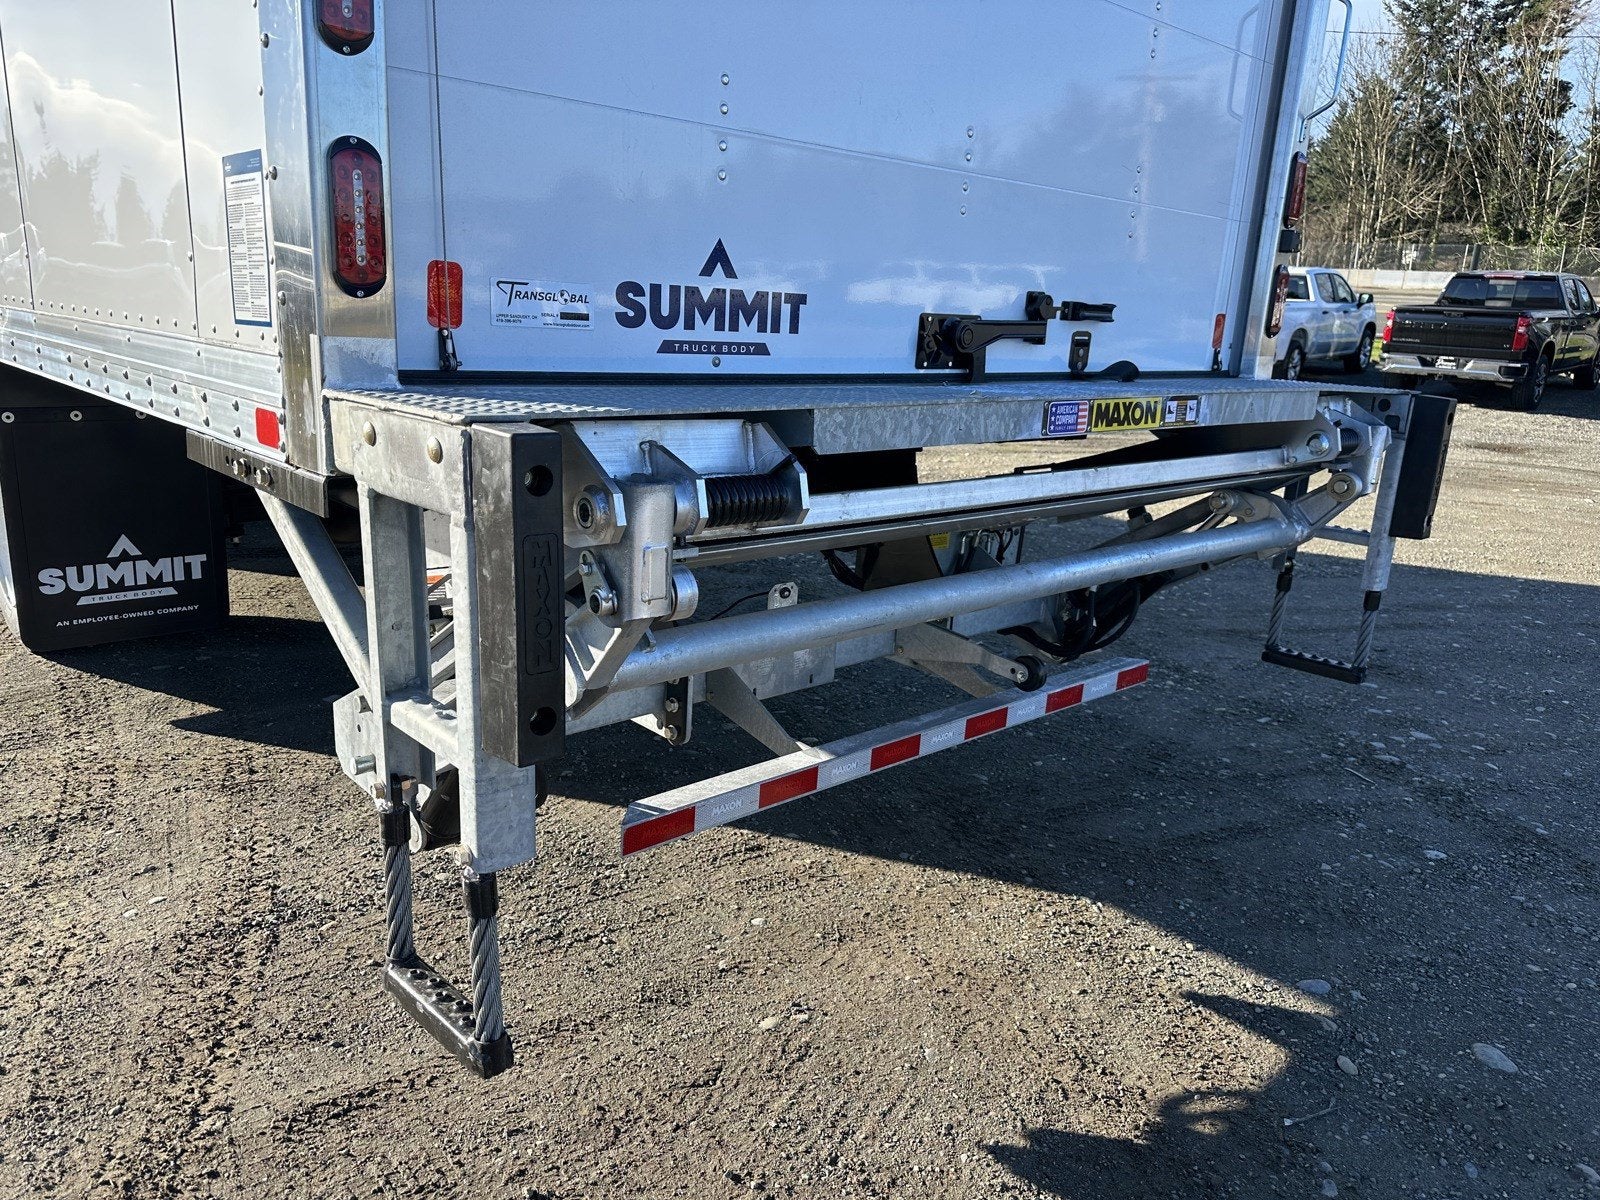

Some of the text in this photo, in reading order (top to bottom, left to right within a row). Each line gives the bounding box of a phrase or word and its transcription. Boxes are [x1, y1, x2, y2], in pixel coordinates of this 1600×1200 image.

[496, 280, 590, 307] TRANSGLOBAL
[614, 280, 808, 335] SUMMIT
[673, 343, 756, 354] TRUCK BODY
[1056, 404, 1079, 415] AMERICAN
[1093, 400, 1159, 429] MAXON
[1055, 414, 1077, 425] COMPANY
[37, 553, 207, 595] SUMMIT
[90, 589, 165, 602] TRUCK BODY
[72, 610, 155, 625] EMPLOYEE-OWNED
[156, 604, 200, 615] COMPANY
[931, 731, 955, 743] MAXON
[831, 761, 859, 776] MAXON
[712, 799, 743, 817] MAXON
